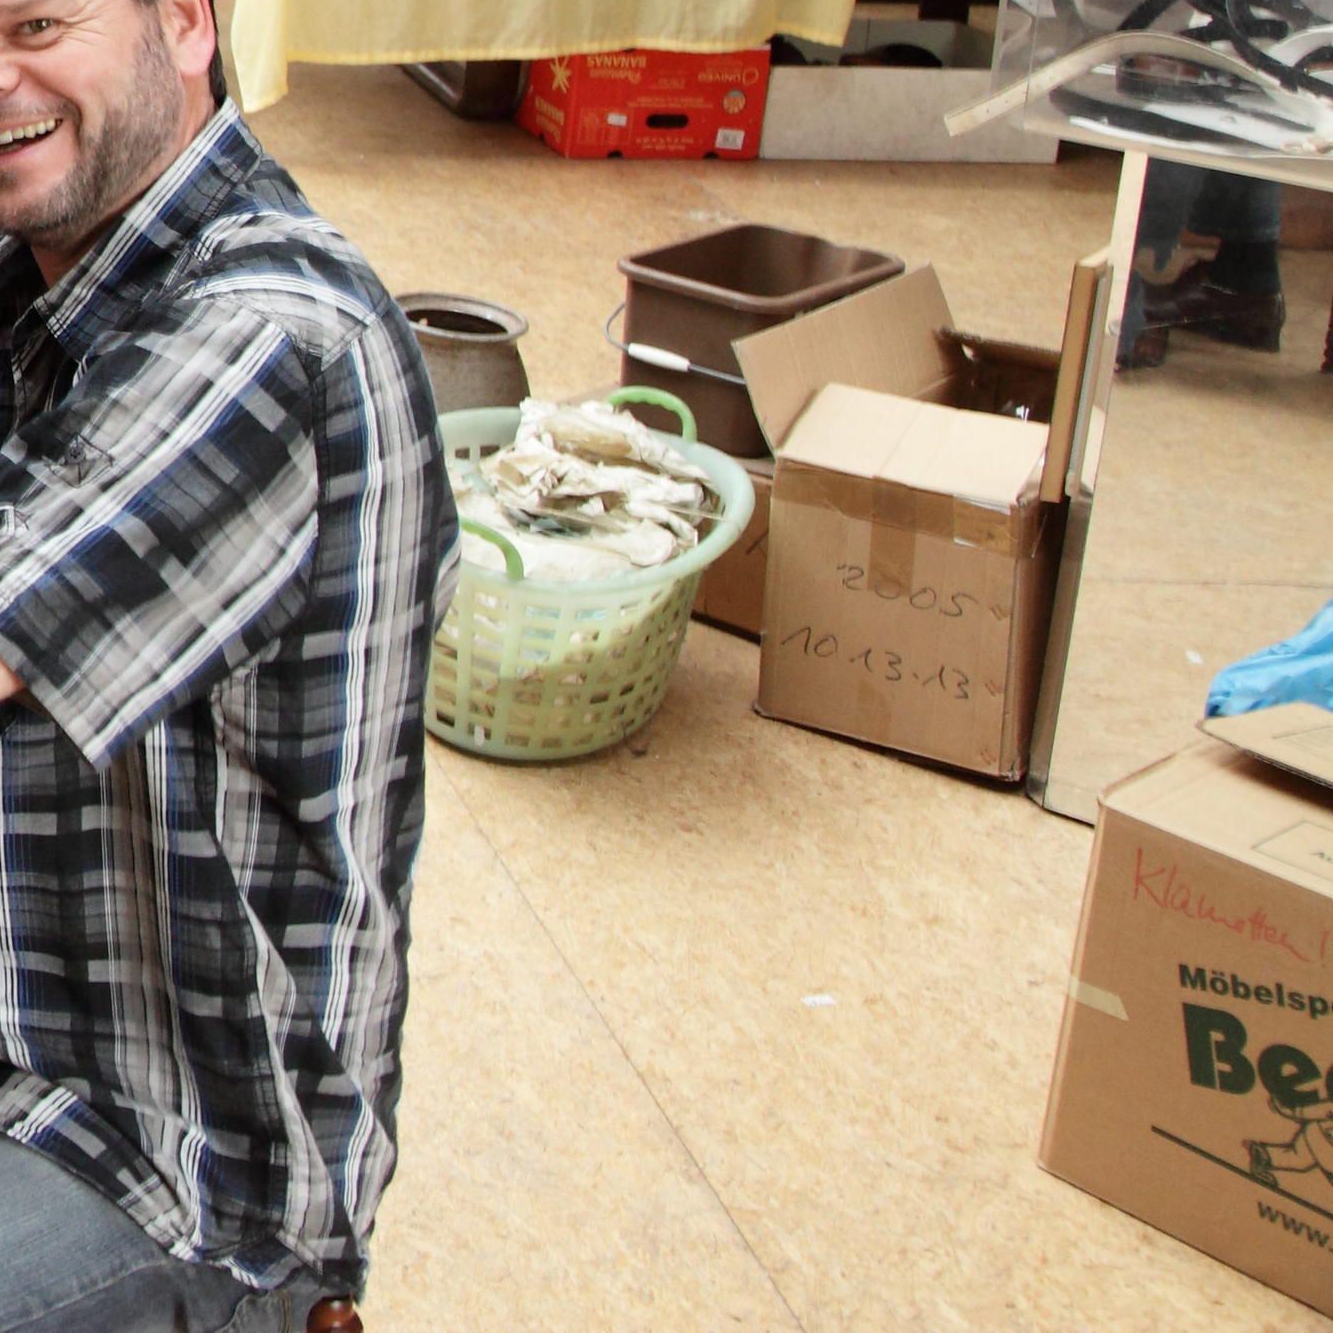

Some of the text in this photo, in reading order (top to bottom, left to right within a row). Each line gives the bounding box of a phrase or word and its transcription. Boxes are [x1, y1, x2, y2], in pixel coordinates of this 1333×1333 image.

[836, 563, 979, 618] 2005
[1178, 962, 1333, 1021] Möbelsp
[1181, 1001, 1333, 1109] Be
